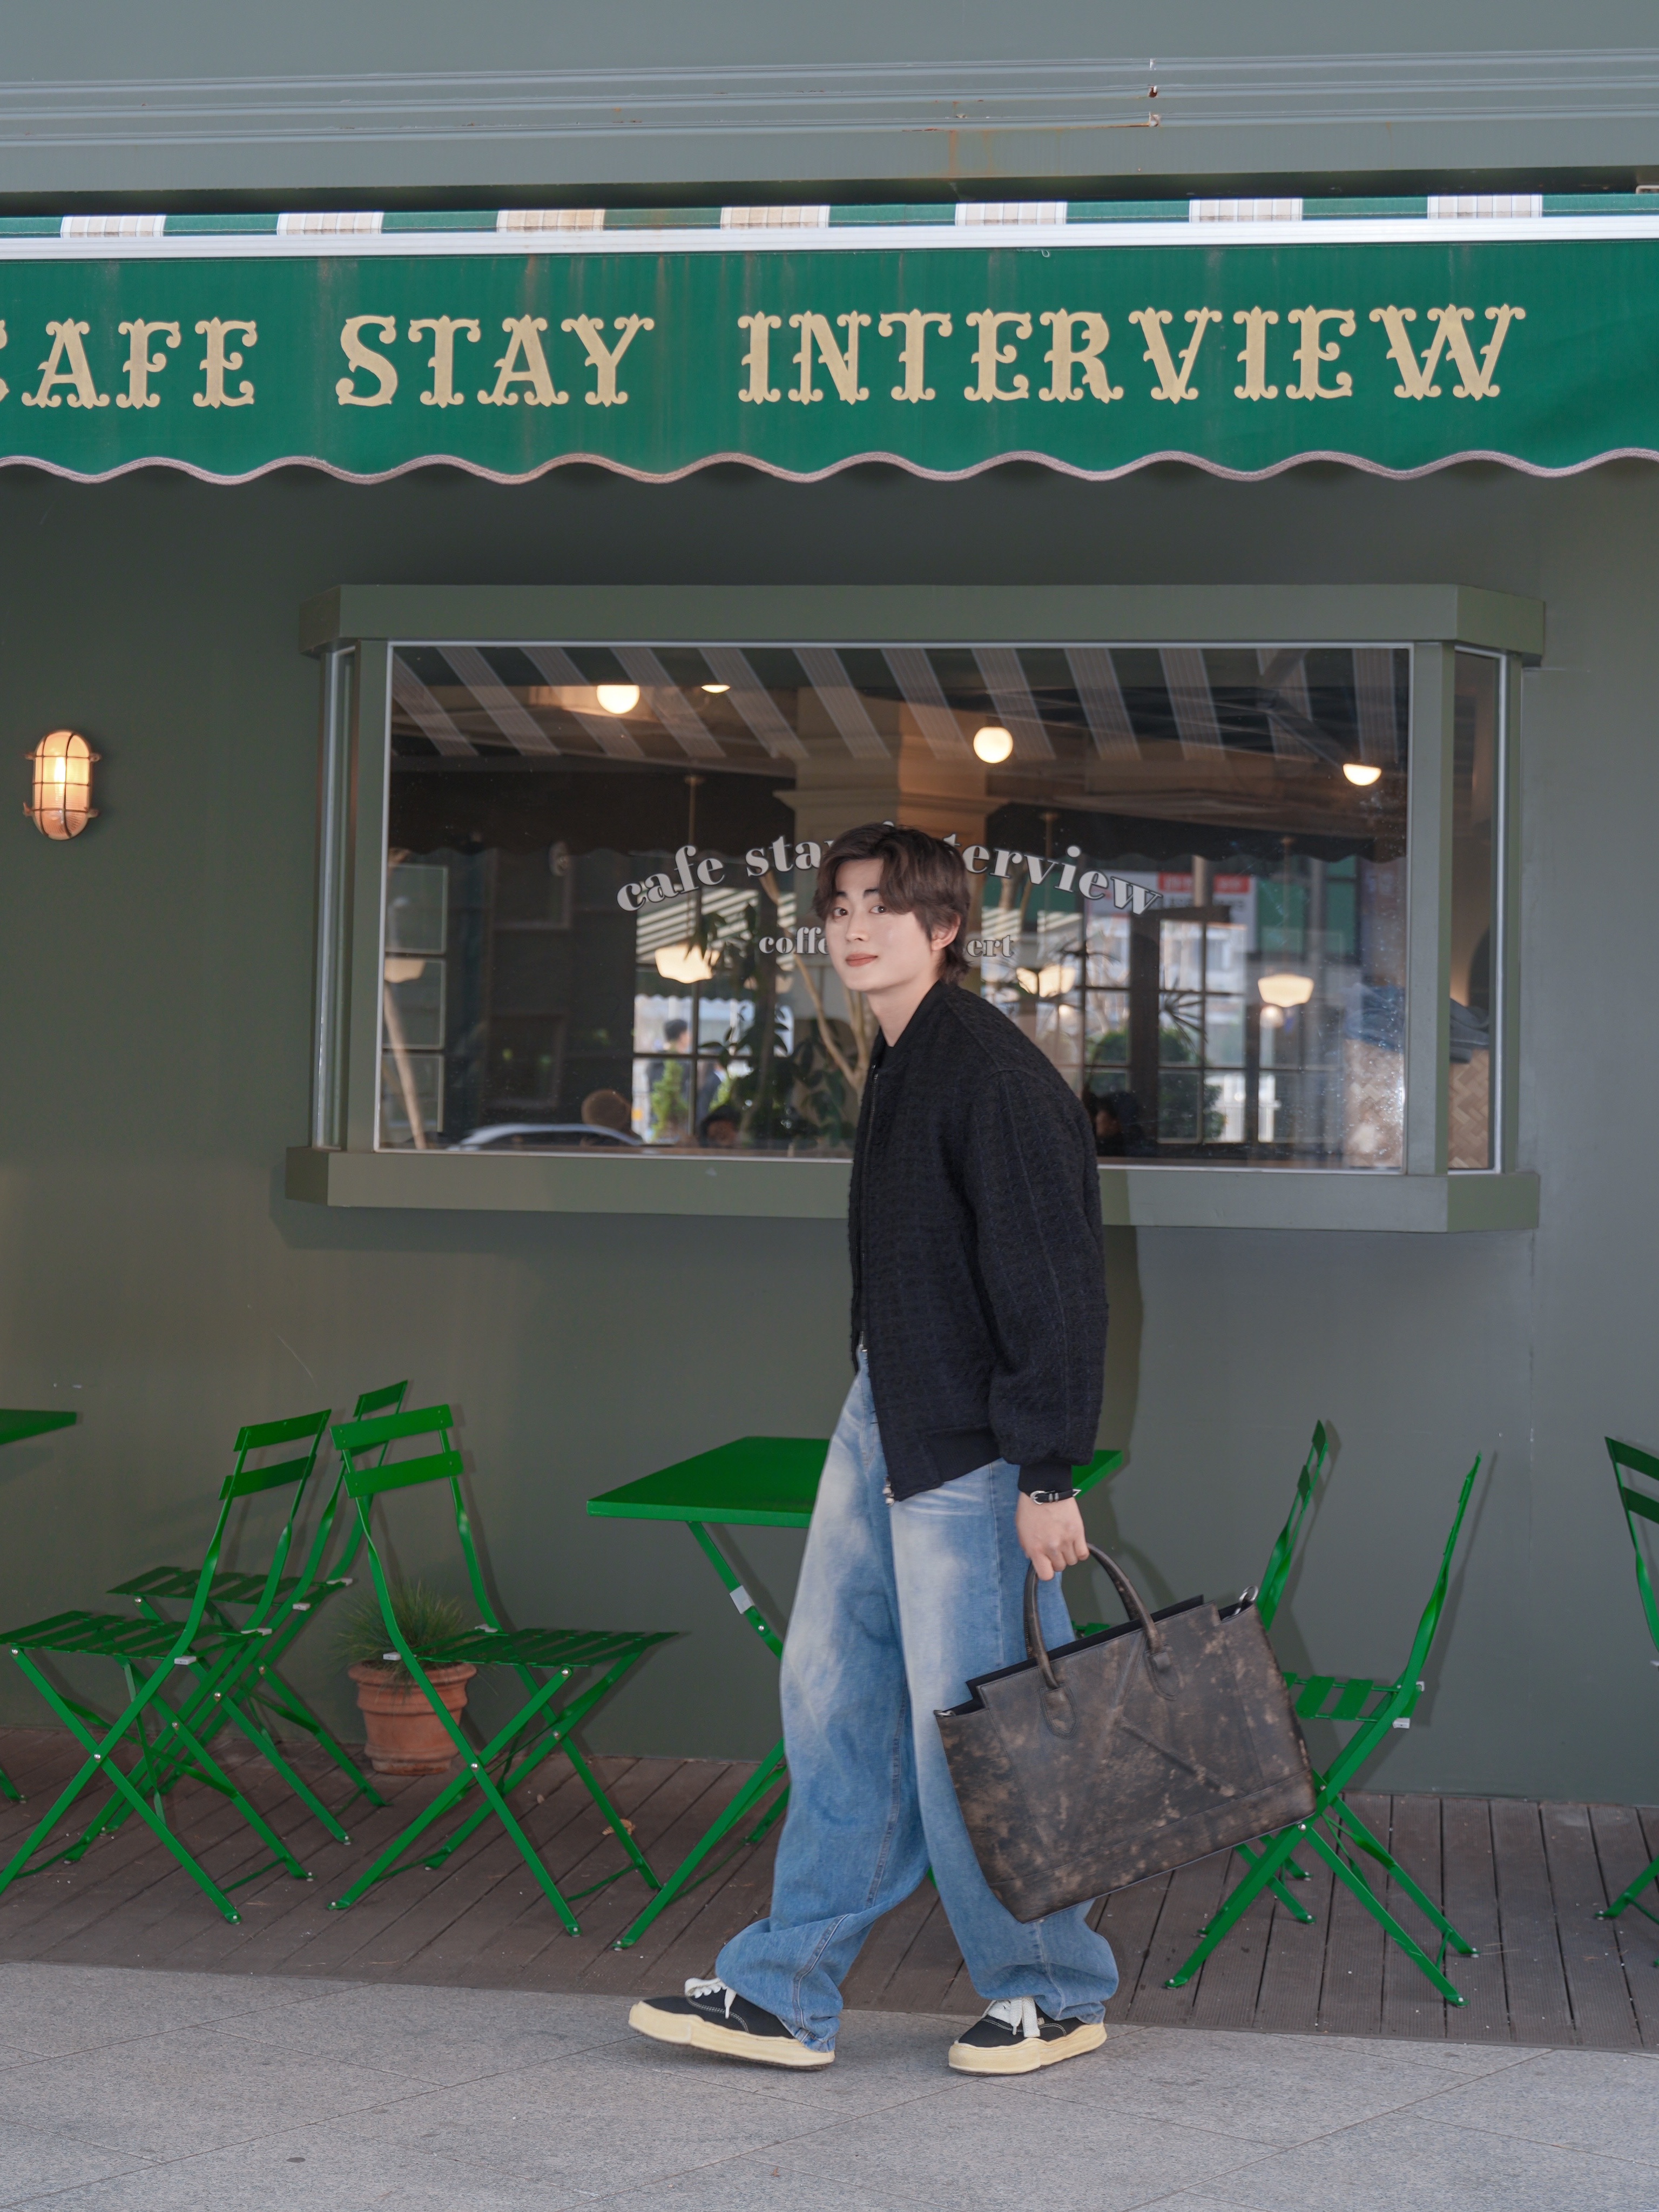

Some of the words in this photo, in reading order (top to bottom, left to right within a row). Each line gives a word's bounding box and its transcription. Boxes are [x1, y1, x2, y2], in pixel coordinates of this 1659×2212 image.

[0, 317, 257, 409] AFE
[335, 314, 654, 408] STAY
[738, 304, 1526, 405] INTERVIEW
[616, 845, 725, 911] cafe
[745, 835, 834, 878] sta
[758, 926, 829, 954] coffe
